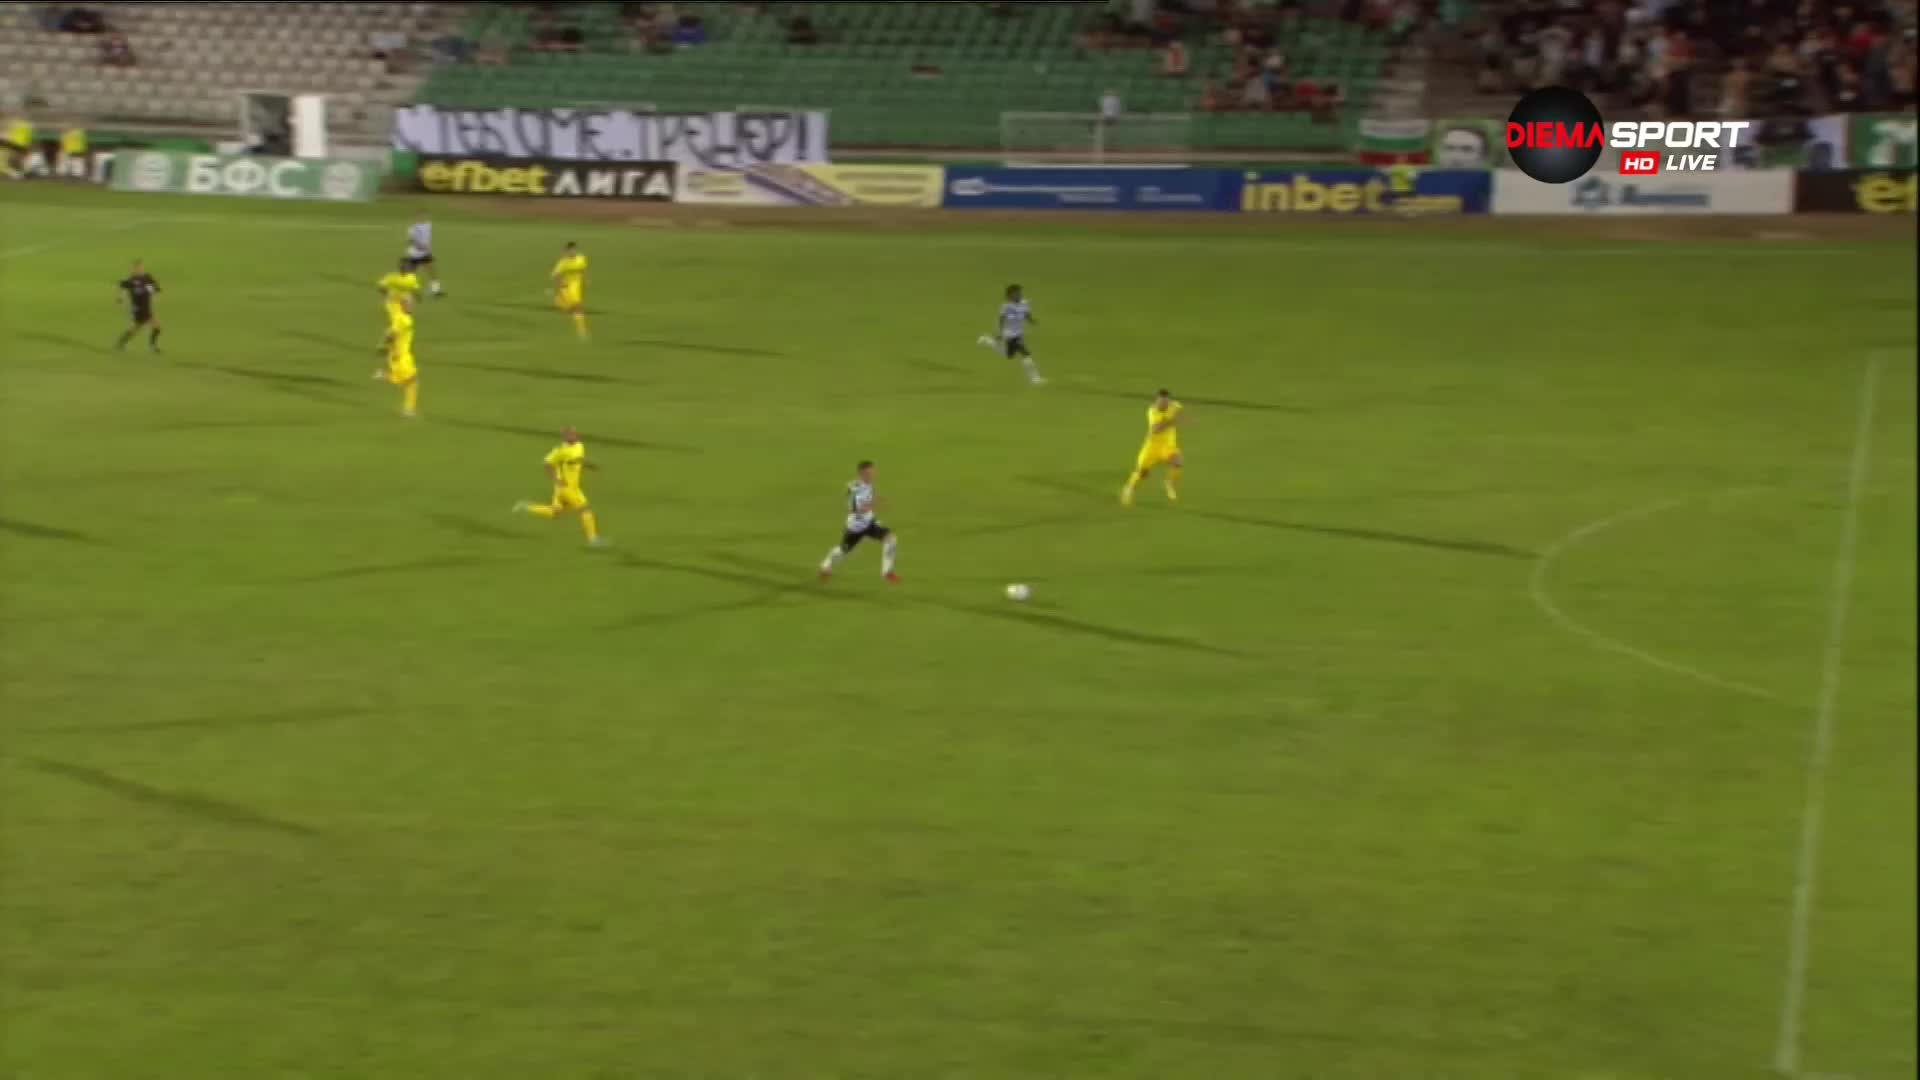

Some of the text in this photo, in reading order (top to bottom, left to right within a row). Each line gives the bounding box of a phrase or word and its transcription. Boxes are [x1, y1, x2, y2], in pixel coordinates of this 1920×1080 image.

[187, 156, 304, 196] БФС
[420, 160, 548, 194] efbet
[552, 170, 672, 196] ЛИГА
